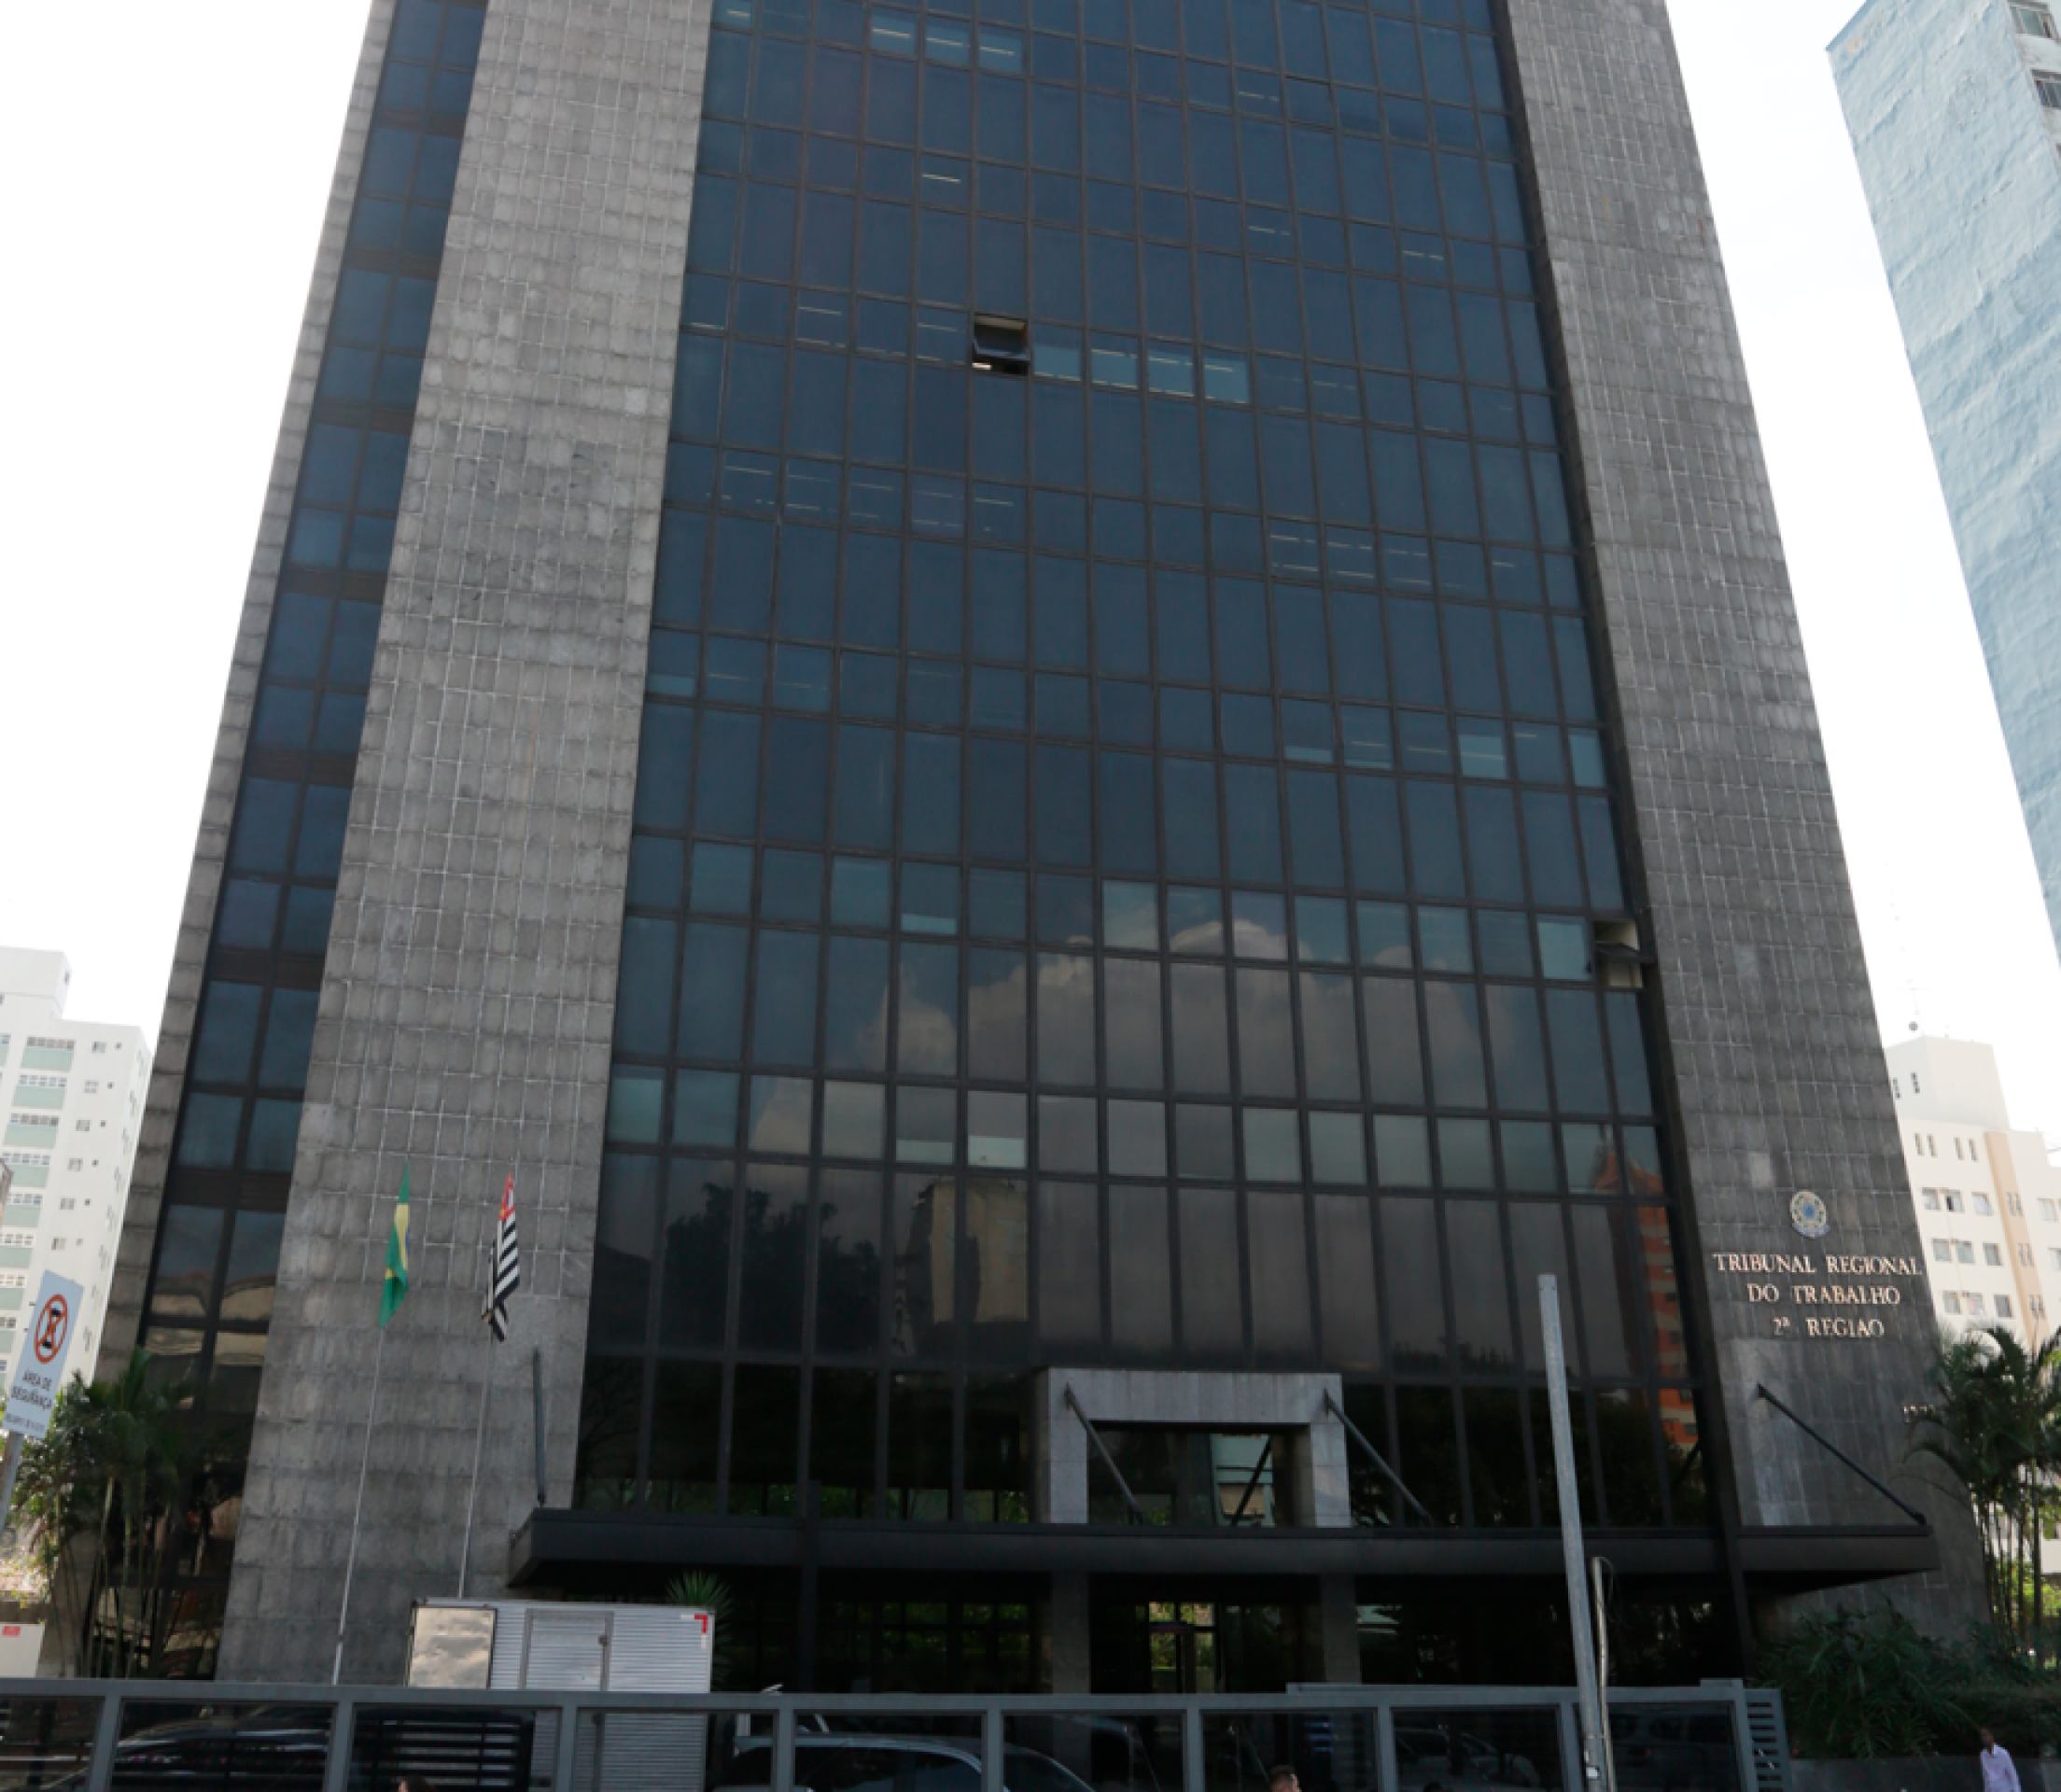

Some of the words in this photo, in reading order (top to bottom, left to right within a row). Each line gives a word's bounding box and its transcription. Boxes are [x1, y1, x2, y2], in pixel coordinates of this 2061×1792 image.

[1712, 1253, 1816, 1273] TRIBUNAL
[1826, 1254, 1922, 1275] REGIONAL
[1746, 1282, 1779, 1302] DO
[1791, 1284, 1900, 1305] TRABALHO
